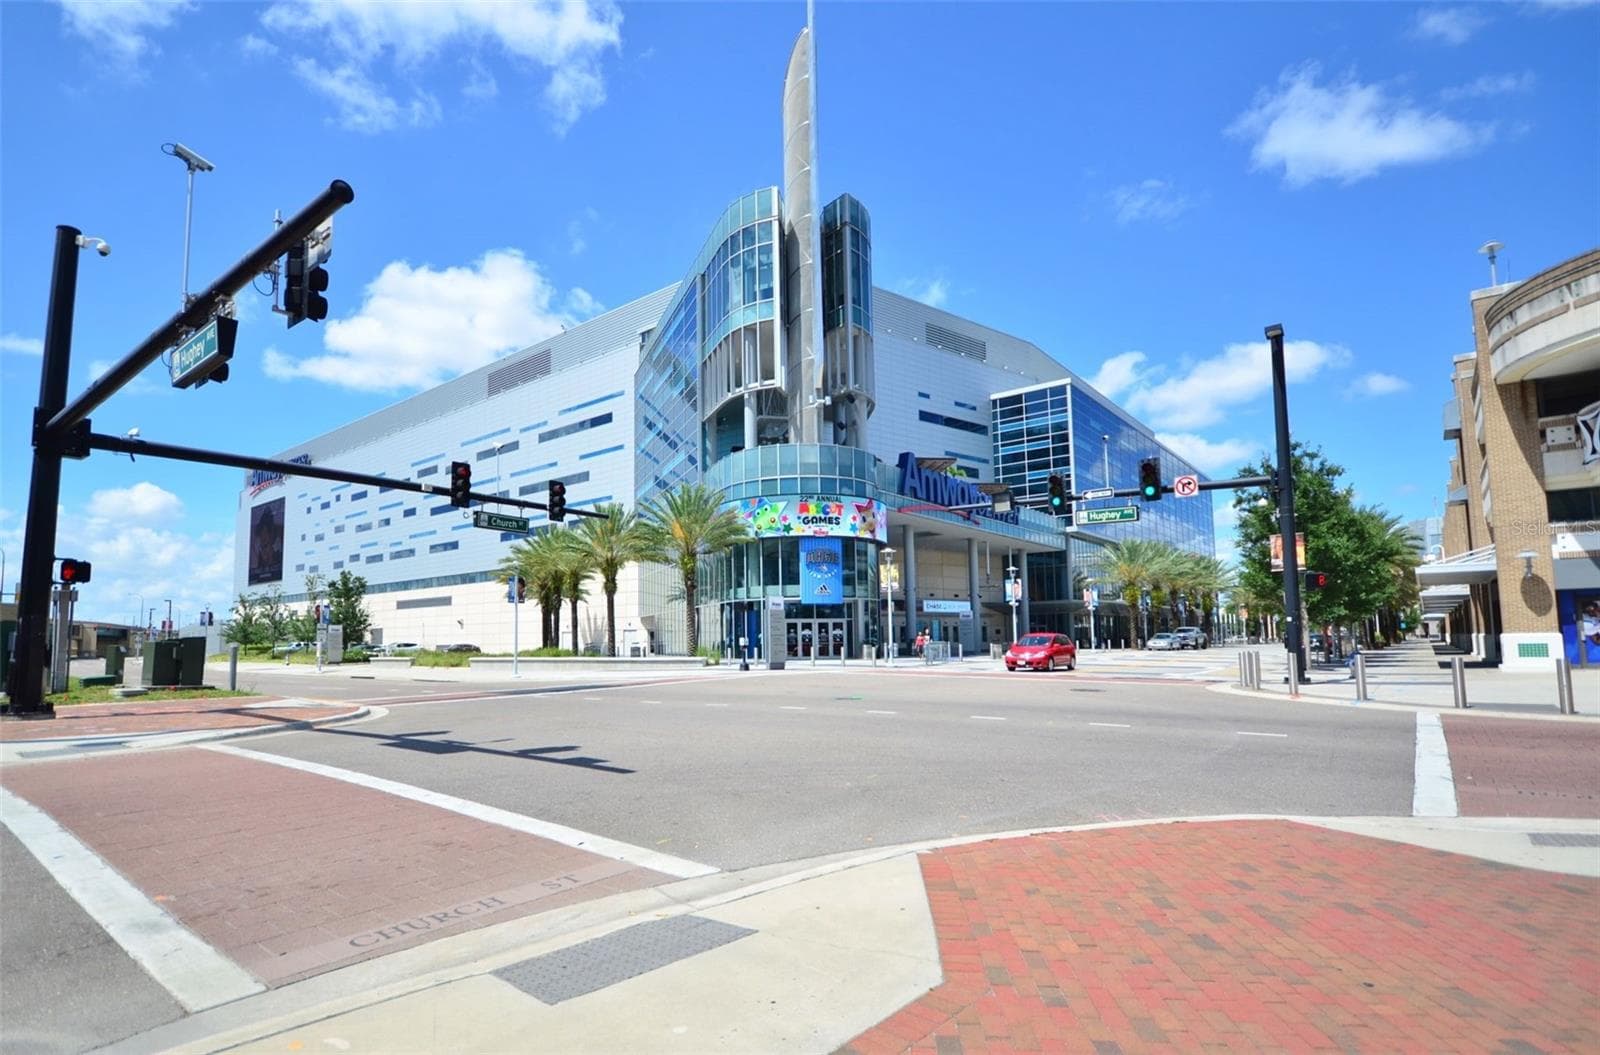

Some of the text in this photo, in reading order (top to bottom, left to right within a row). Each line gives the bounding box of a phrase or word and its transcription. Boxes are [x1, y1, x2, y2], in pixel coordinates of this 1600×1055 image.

[181, 339, 205, 369] Hughey
[815, 495, 842, 503] ANNUAL
[802, 516, 841, 526] GAMES
[1089, 511, 1121, 522] Hughey
[491, 517, 518, 528] Church
[349, 873, 582, 948] CHURCH ST
